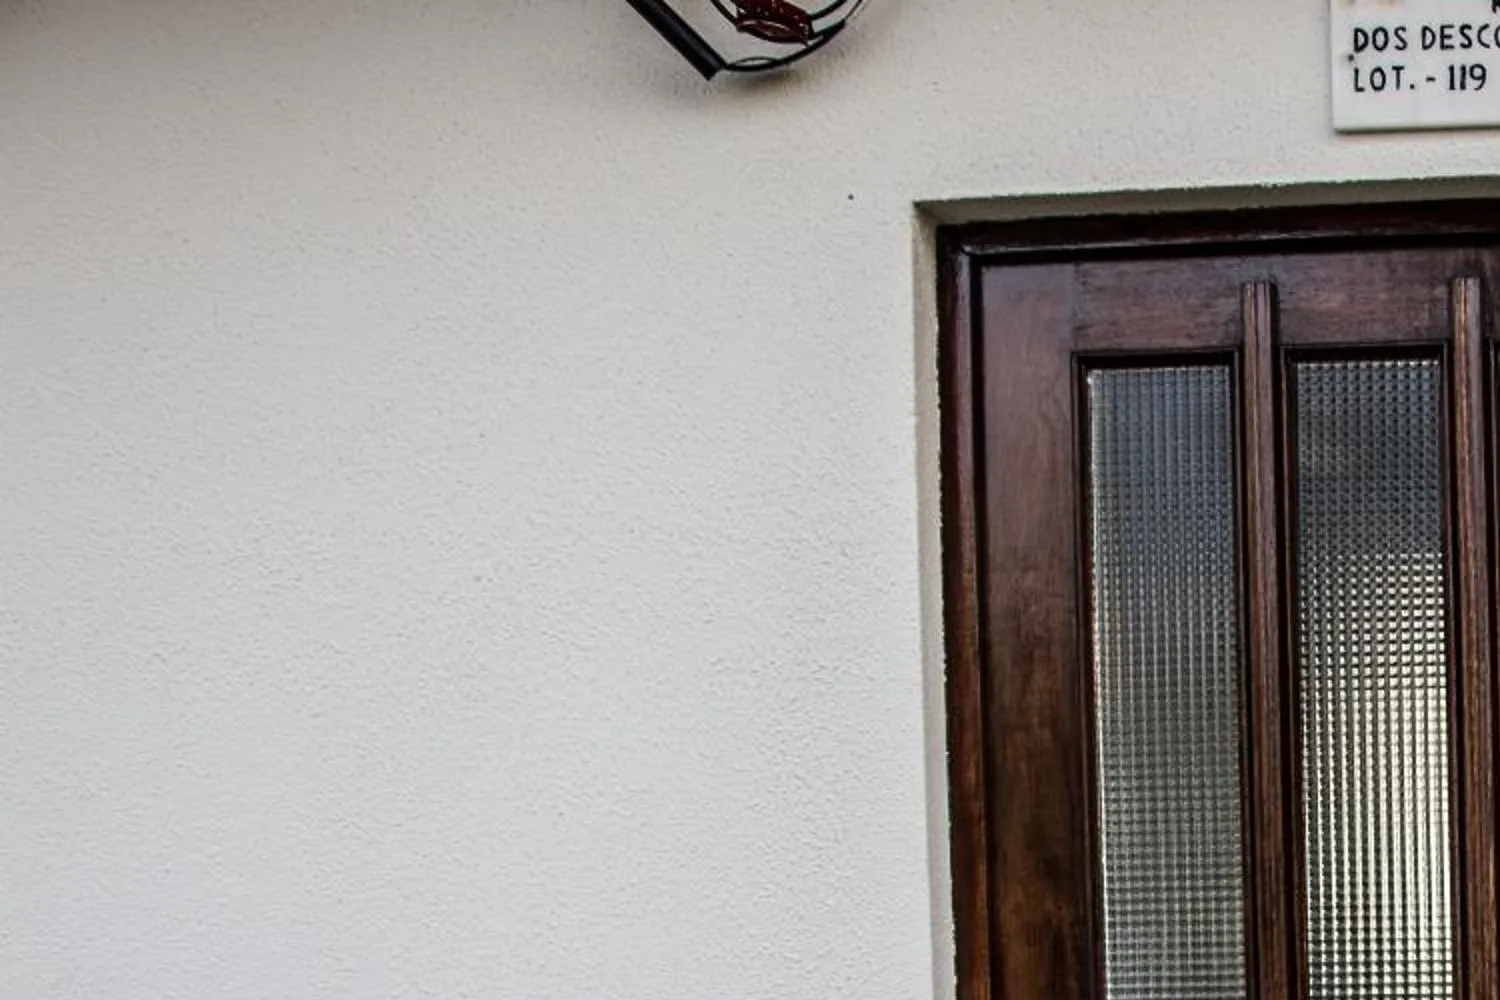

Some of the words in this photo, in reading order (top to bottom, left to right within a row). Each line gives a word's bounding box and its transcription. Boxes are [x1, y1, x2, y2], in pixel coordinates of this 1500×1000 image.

[1352, 26, 1408, 53] DOS
[1353, 65, 1416, 93] LOT.
[1447, 63, 1487, 91] 119
